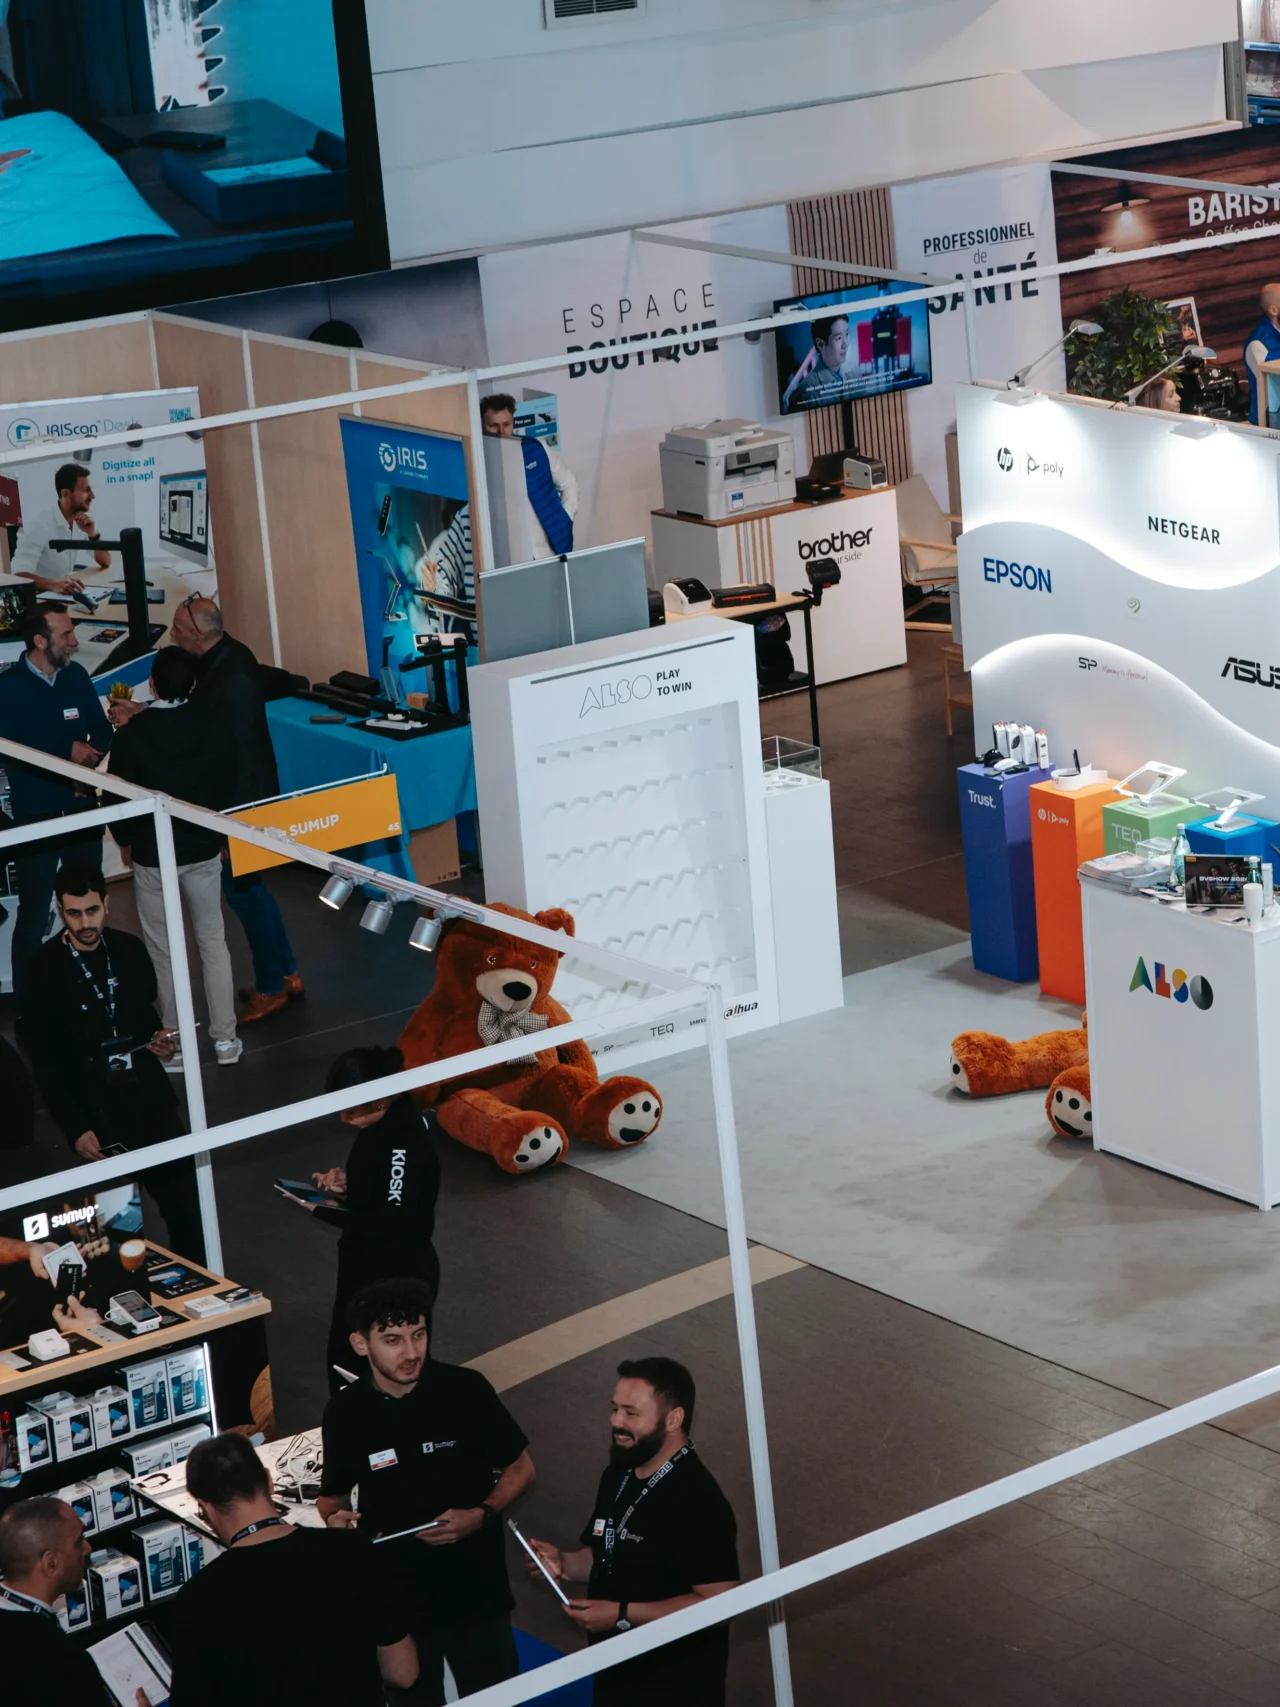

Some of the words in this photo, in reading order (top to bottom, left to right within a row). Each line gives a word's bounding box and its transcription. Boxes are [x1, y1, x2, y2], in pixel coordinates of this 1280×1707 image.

[923, 222, 1035, 254] PROFESSIONNEL
[973, 249, 987, 264] de
[562, 283, 715, 334] ESPACE
[46, 421, 98, 437] IRIScan
[102, 459, 141, 472] Digitize
[144, 457, 155, 468] all
[1044, 462, 1064, 478] poly
[106, 475, 116, 484] in
[119, 475, 125, 483] a
[127, 470, 154, 484] snap!
[1148, 515, 1221, 545] NETGEAR
[798, 527, 872, 560] brother
[844, 551, 862, 563] side
[983, 557, 1052, 594] EPSON
[1078, 656, 1098, 670] SP
[656, 668, 680, 681] PLAY
[579, 674, 652, 719] ALSO
[656, 686, 670, 696] TO
[672, 682, 692, 694] WIN
[289, 814, 339, 836] SUMUP
[388, 823, 400, 832] 45
[1112, 822, 1142, 844] TEQ
[1129, 956, 1214, 1011] ALSO
[650, 1022, 674, 1037] TEQ
